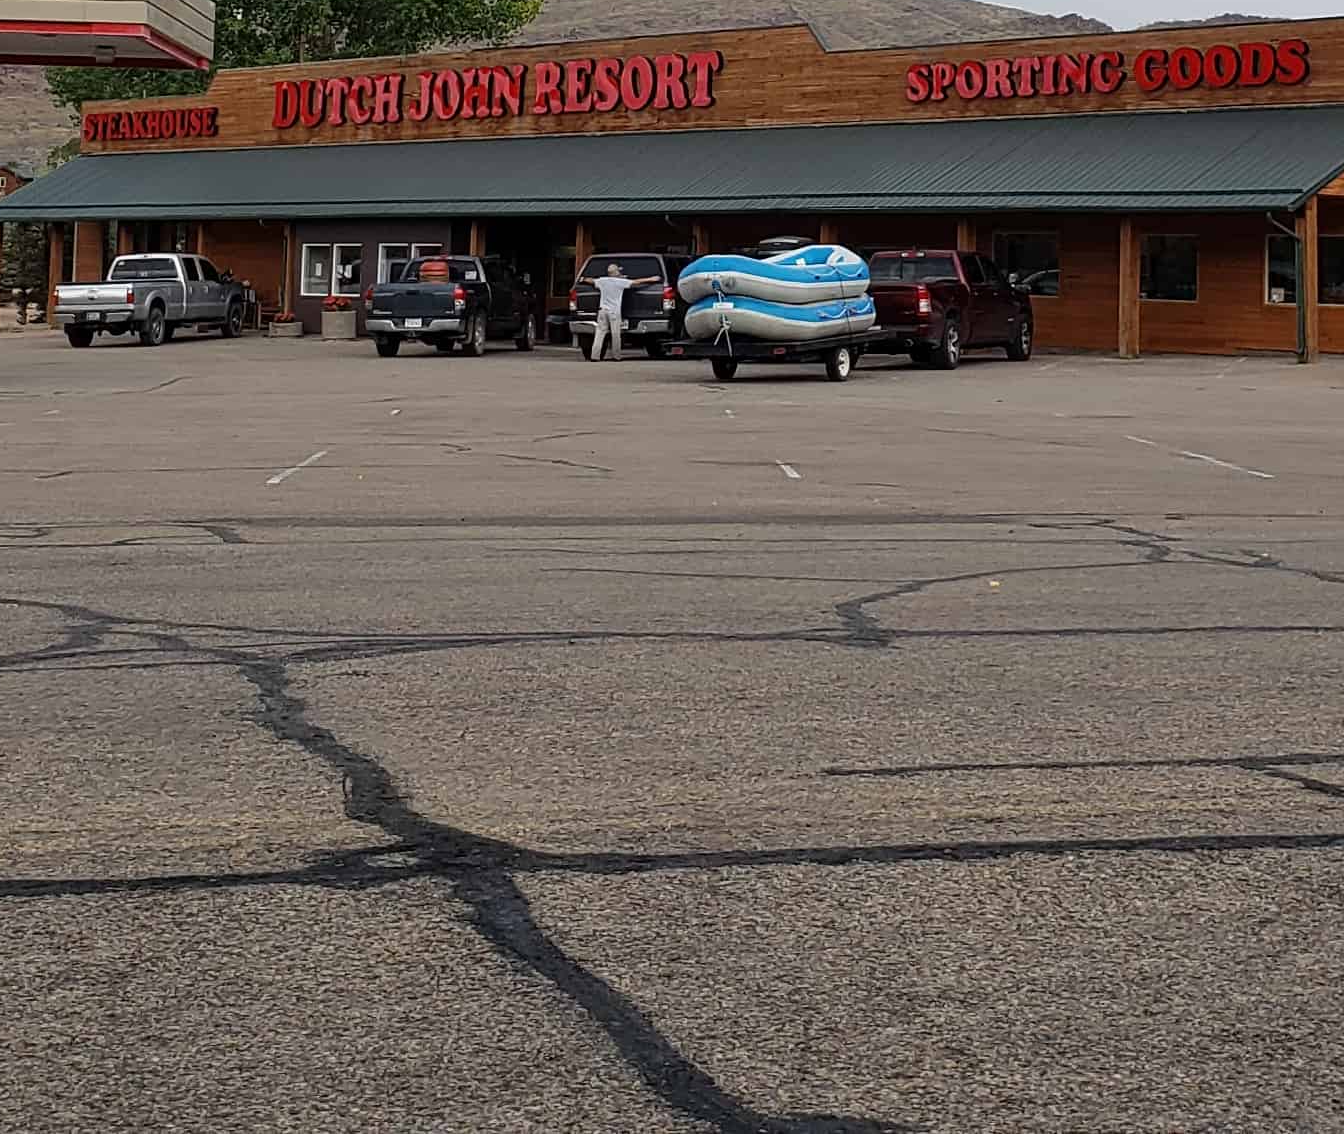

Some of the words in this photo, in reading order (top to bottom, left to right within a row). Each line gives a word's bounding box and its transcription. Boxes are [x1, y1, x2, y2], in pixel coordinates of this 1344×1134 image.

[272, 72, 402, 128] DUTCH
[409, 65, 527, 122] JOHN
[534, 50, 721, 115] RESORT
[906, 50, 1124, 102] SPORTING
[1133, 39, 1308, 91] GOODS
[83, 107, 218, 141] STEAKHOUSE
